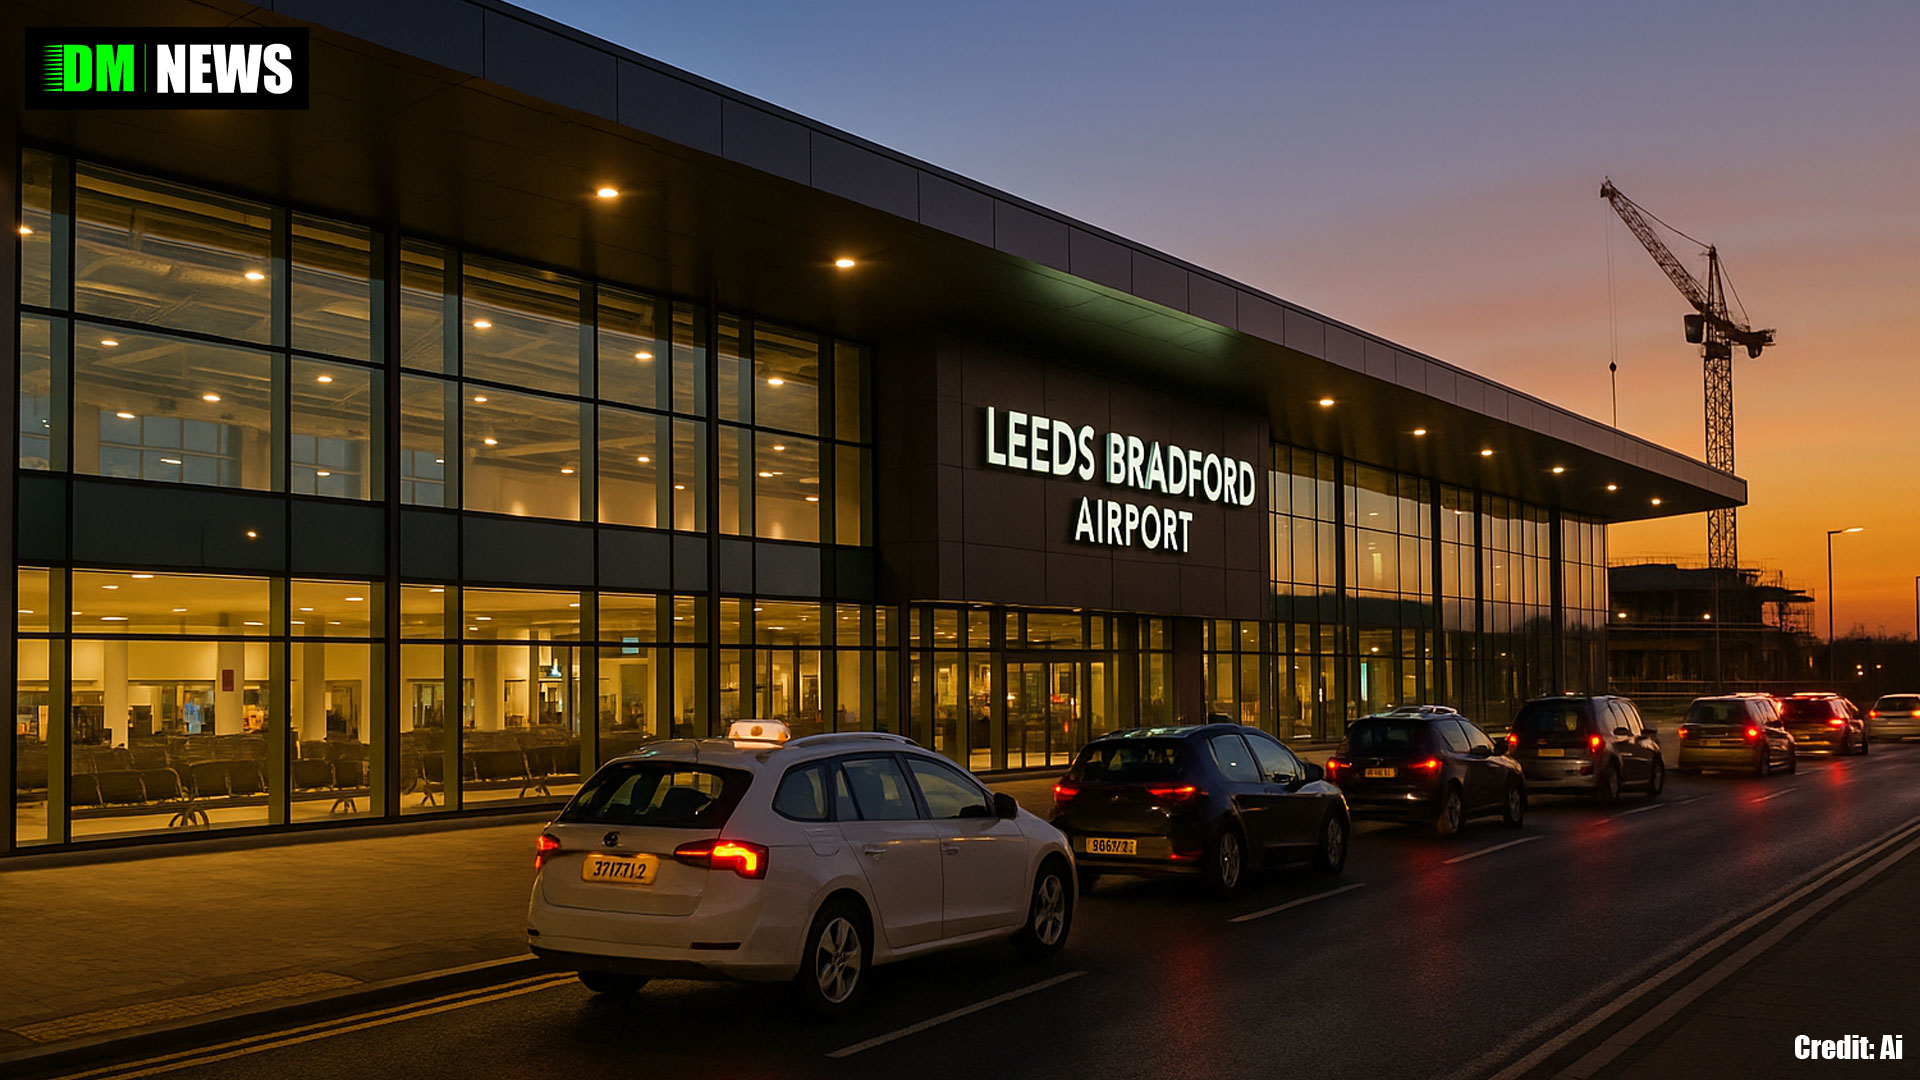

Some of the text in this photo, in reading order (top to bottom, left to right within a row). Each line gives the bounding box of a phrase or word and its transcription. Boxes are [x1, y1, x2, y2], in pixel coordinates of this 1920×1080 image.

[986, 406, 1256, 506] LEEDS BRADFORD
[1074, 496, 1193, 553] AIRPORT
